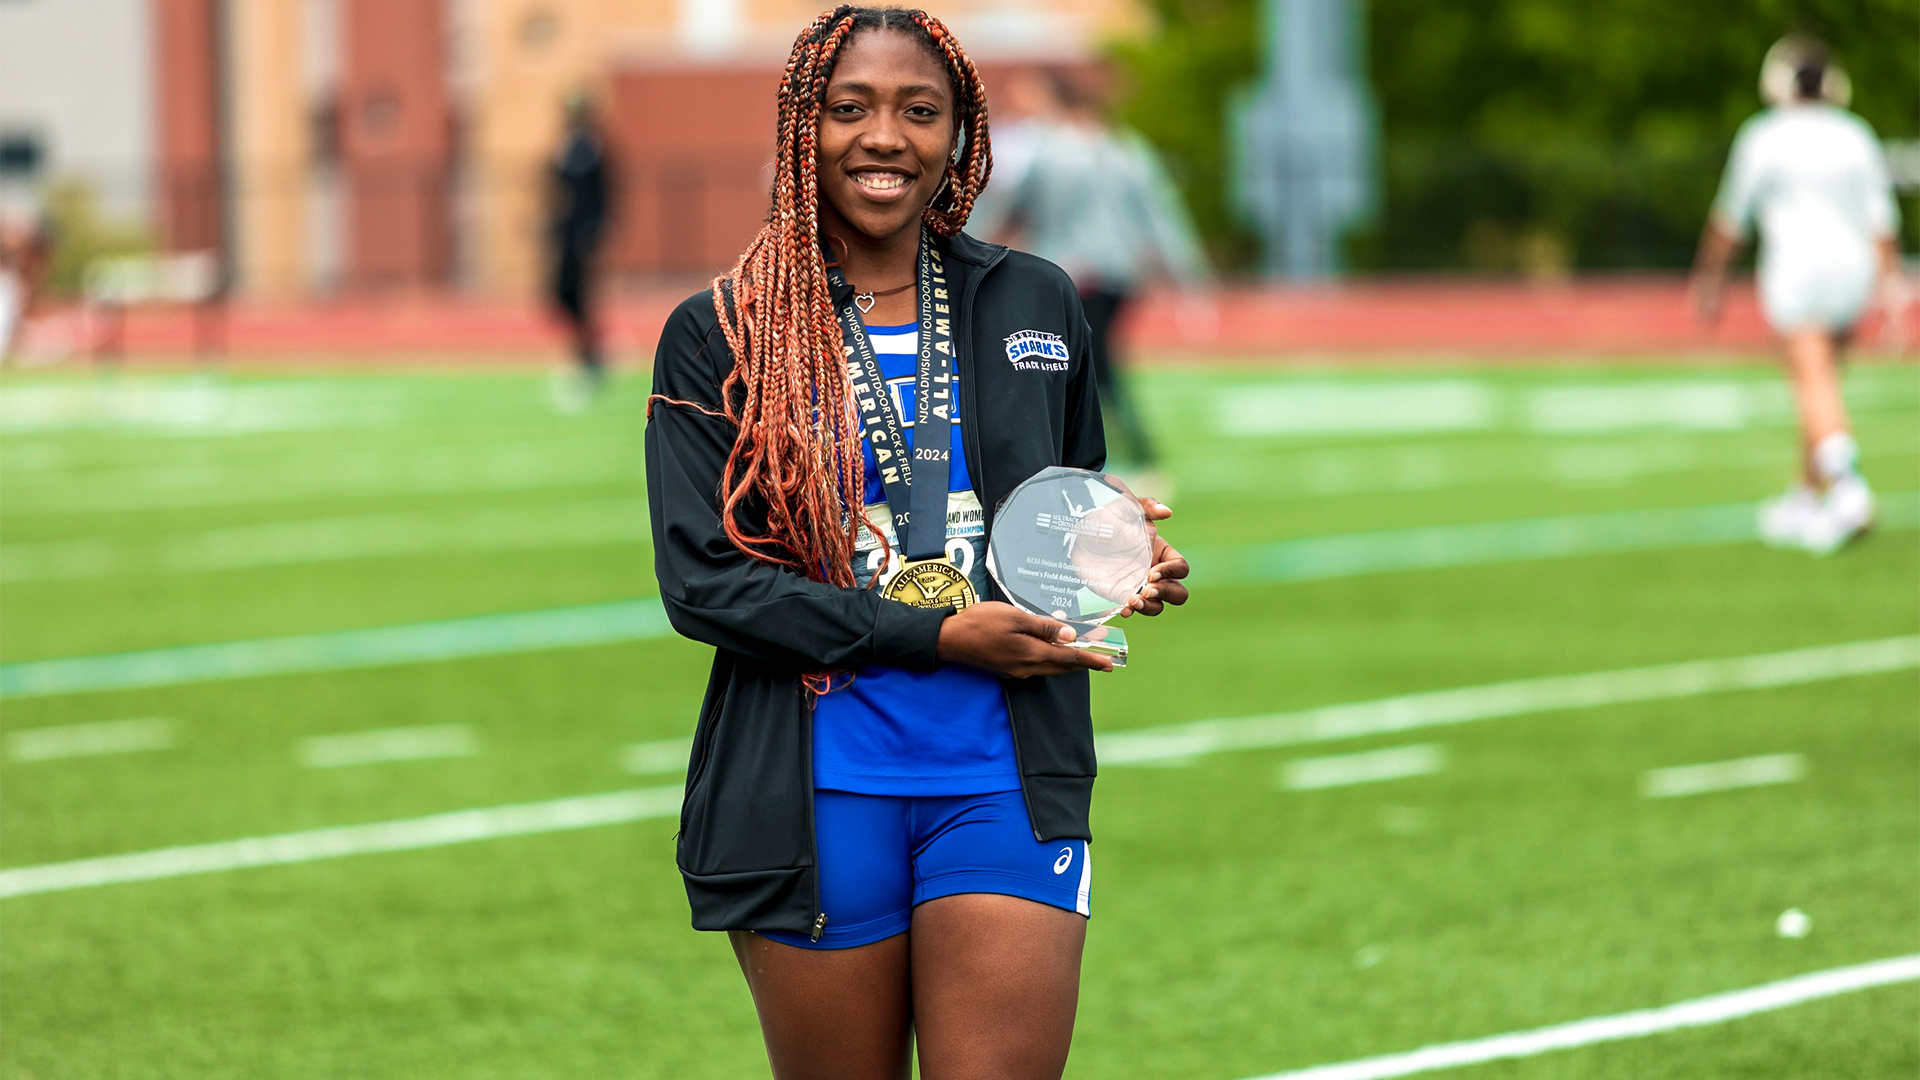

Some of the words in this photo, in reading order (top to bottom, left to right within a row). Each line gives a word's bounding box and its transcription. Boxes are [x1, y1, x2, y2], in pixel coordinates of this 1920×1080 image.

[921, 249, 930, 279] TRACK
[922, 280, 932, 330] OUTDOOR
[843, 306, 868, 350] DIVISION
[922, 330, 932, 341] III
[860, 349, 872, 360] III
[1009, 340, 1066, 360] SHARKS
[920, 342, 931, 388] DIVISION
[1012, 361, 1040, 371] TRACK
[1045, 362, 1069, 371] FIELD
[865, 360, 891, 413] OUTDOOR
[919, 389, 929, 424] NJCAA
[885, 413, 903, 448] TRACK
[895, 449, 905, 457] &
[915, 448, 949, 461] 2024
[896, 564, 962, 591] ALL-AMERICAN
[1017, 566, 1044, 578] Women's
[1043, 571, 1059, 580] Field
[1058, 574, 1081, 584] Athlete
[1040, 583, 1067, 593] Northeast
[1051, 595, 1072, 608] 2024
